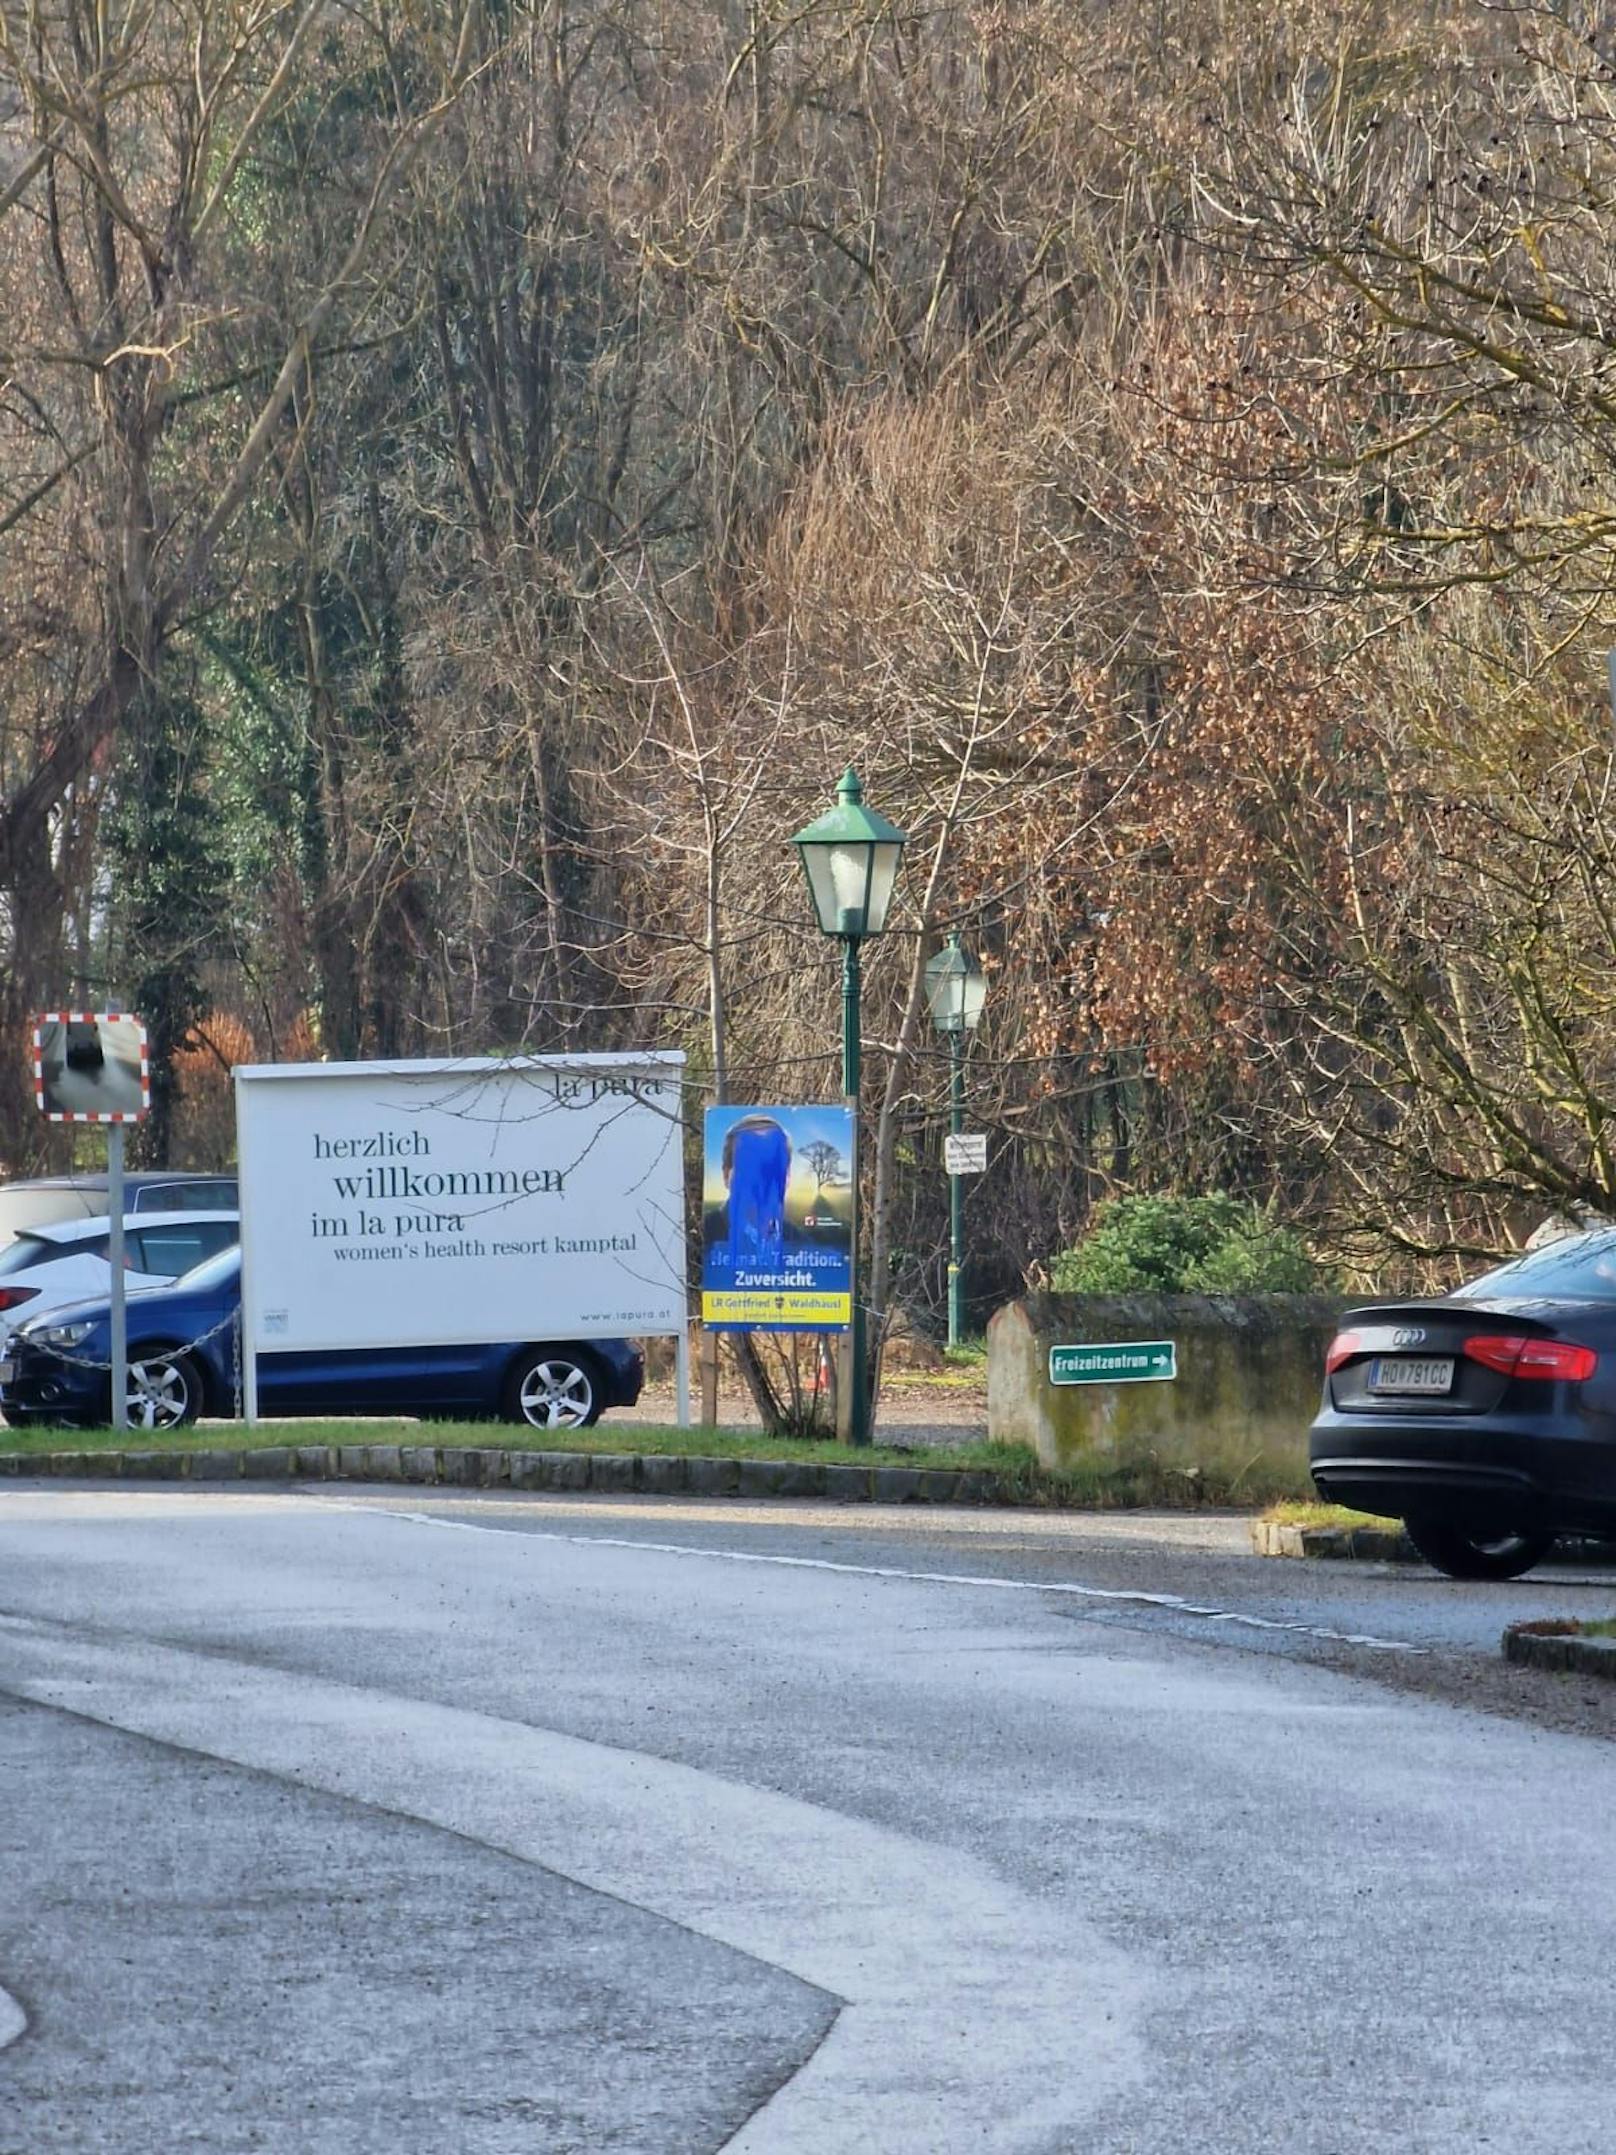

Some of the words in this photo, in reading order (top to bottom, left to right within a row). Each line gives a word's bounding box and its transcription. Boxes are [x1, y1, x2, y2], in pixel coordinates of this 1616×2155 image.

[555, 1074, 581, 1098] la
[313, 1131, 431, 1159] herzlich
[333, 1166, 566, 1199] willkommen
[312, 1212, 349, 1237] im
[359, 1210, 386, 1236] la
[396, 1213, 465, 1237] pura
[425, 1239, 486, 1258] health
[492, 1238, 549, 1256] resort
[554, 1234, 637, 1255] kamptal
[735, 1270, 817, 1288] Zuversicht.
[580, 1309, 671, 1321] www.lapura.at
[725, 1297, 770, 1310] Gottfried
[1055, 1353, 1148, 1371] Freizeitzentrum
